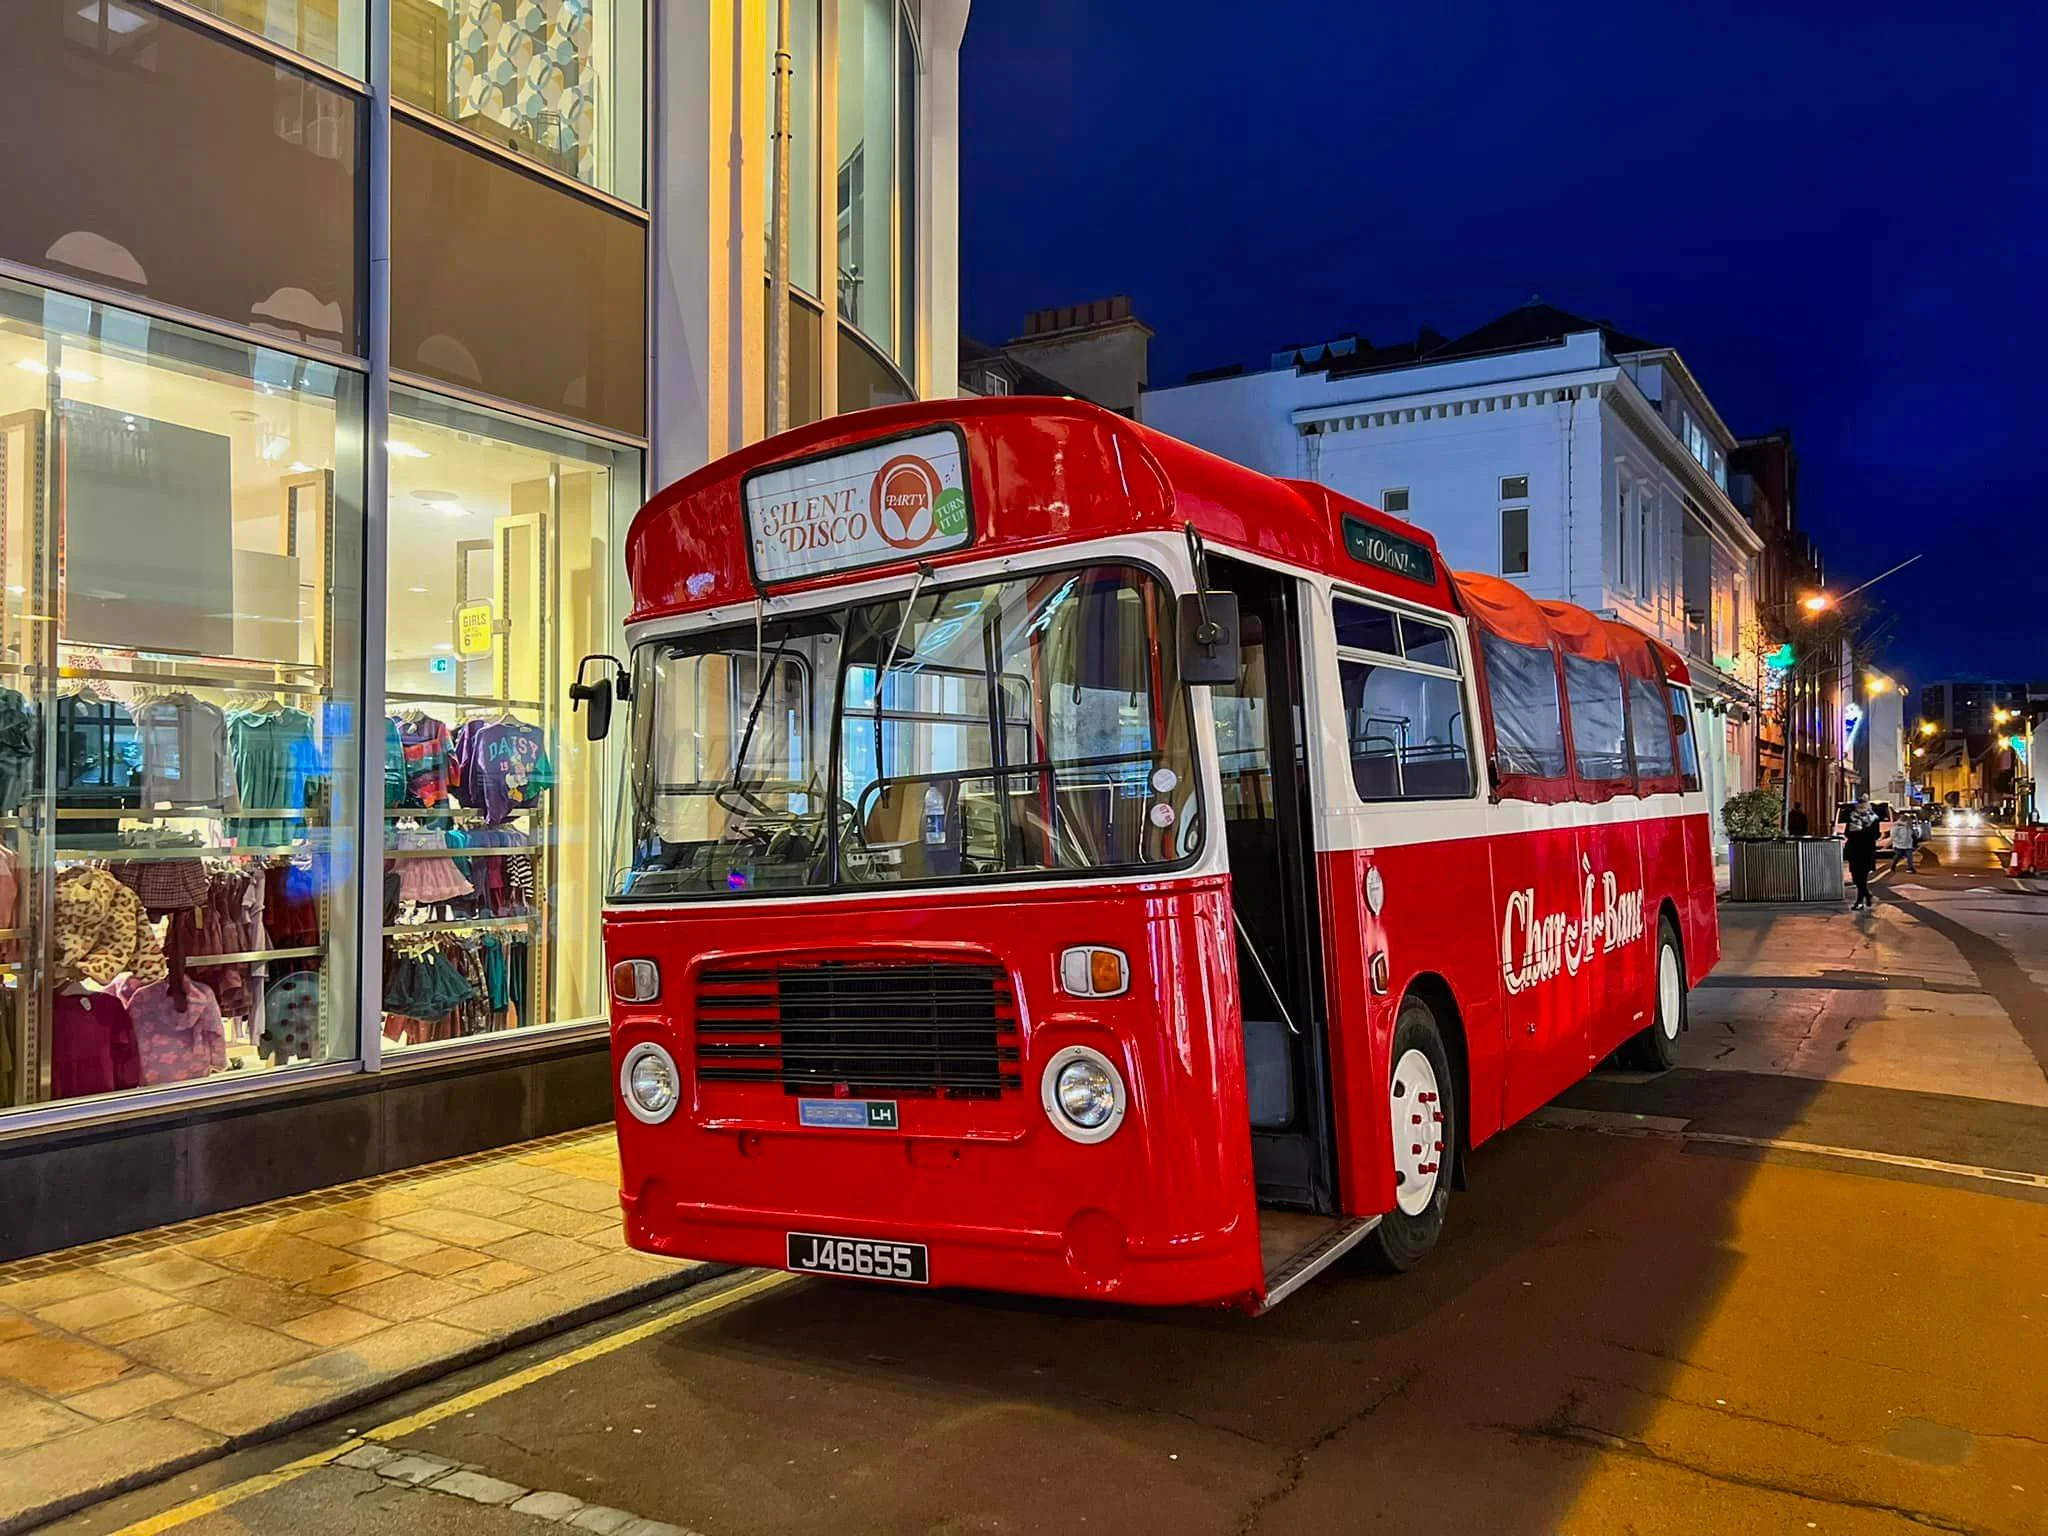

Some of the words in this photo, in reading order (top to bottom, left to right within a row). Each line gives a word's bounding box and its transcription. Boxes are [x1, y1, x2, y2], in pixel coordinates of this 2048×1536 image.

[886, 493, 926, 507] PARTY
[763, 488, 856, 536] SILENT
[779, 512, 868, 553] DISCO
[940, 515, 951, 530] IT
[463, 612, 487, 628] GIRLS
[464, 634, 471, 646] 6
[489, 736, 538, 761] DAISY
[1501, 887, 1566, 995] Char
[871, 1108, 892, 1121] LH
[801, 1238, 912, 1279] J46655
